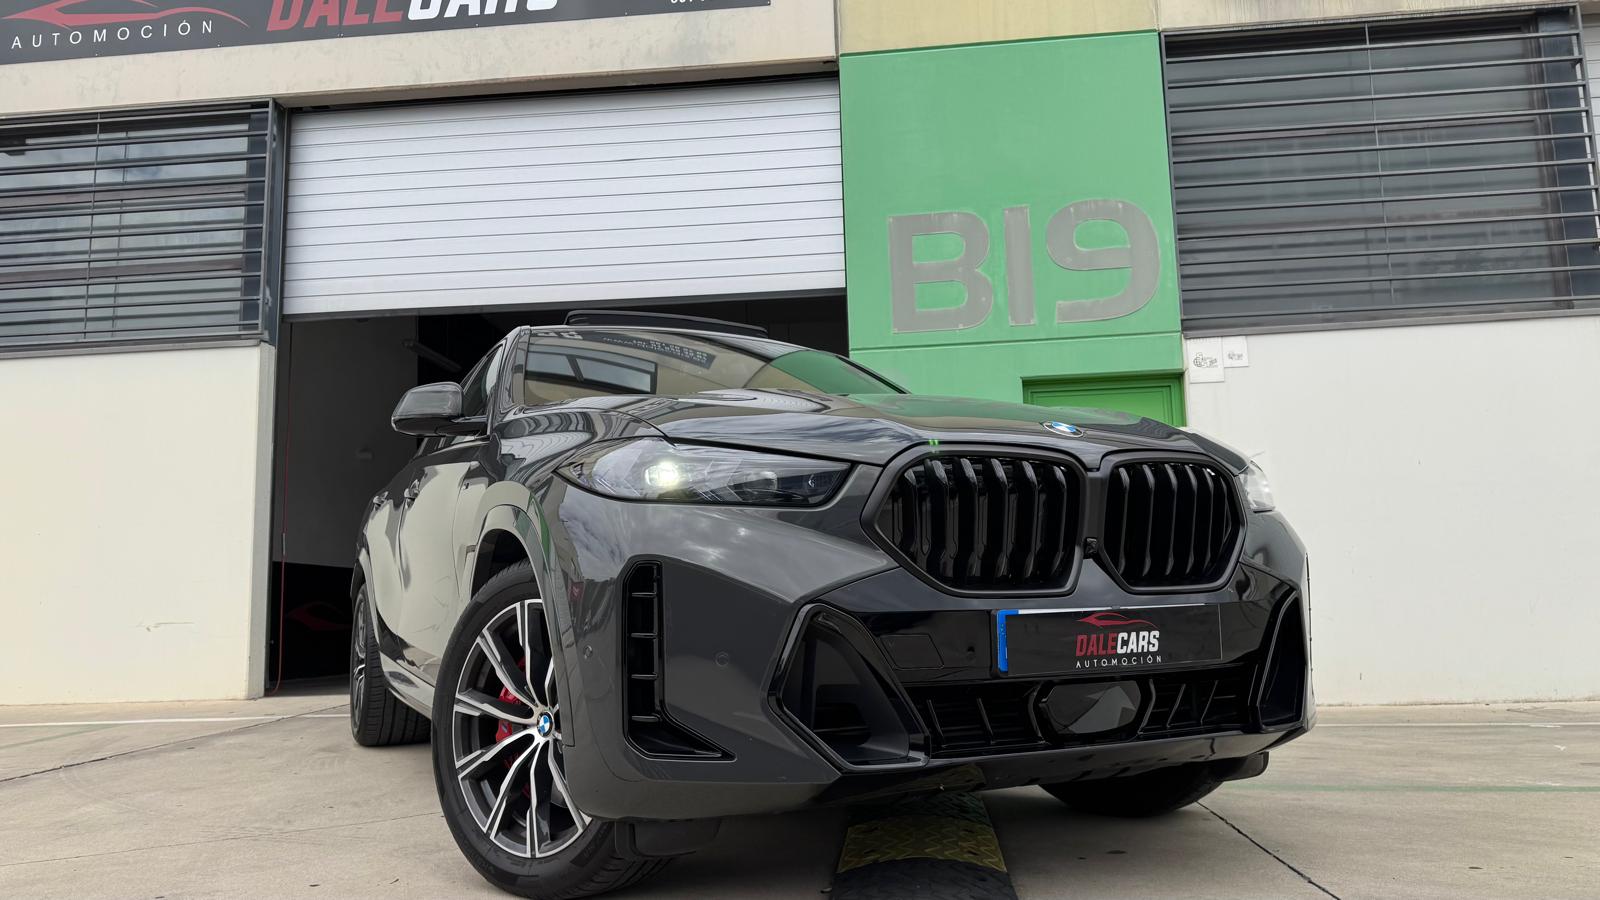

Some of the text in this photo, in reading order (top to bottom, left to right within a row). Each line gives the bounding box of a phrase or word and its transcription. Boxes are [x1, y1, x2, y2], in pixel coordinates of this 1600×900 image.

[11, 20, 213, 49] AUTOMOCIÓN
[1076, 631, 1159, 656] DALECARS
[1075, 655, 1162, 668] AUTOMOCIÓN
